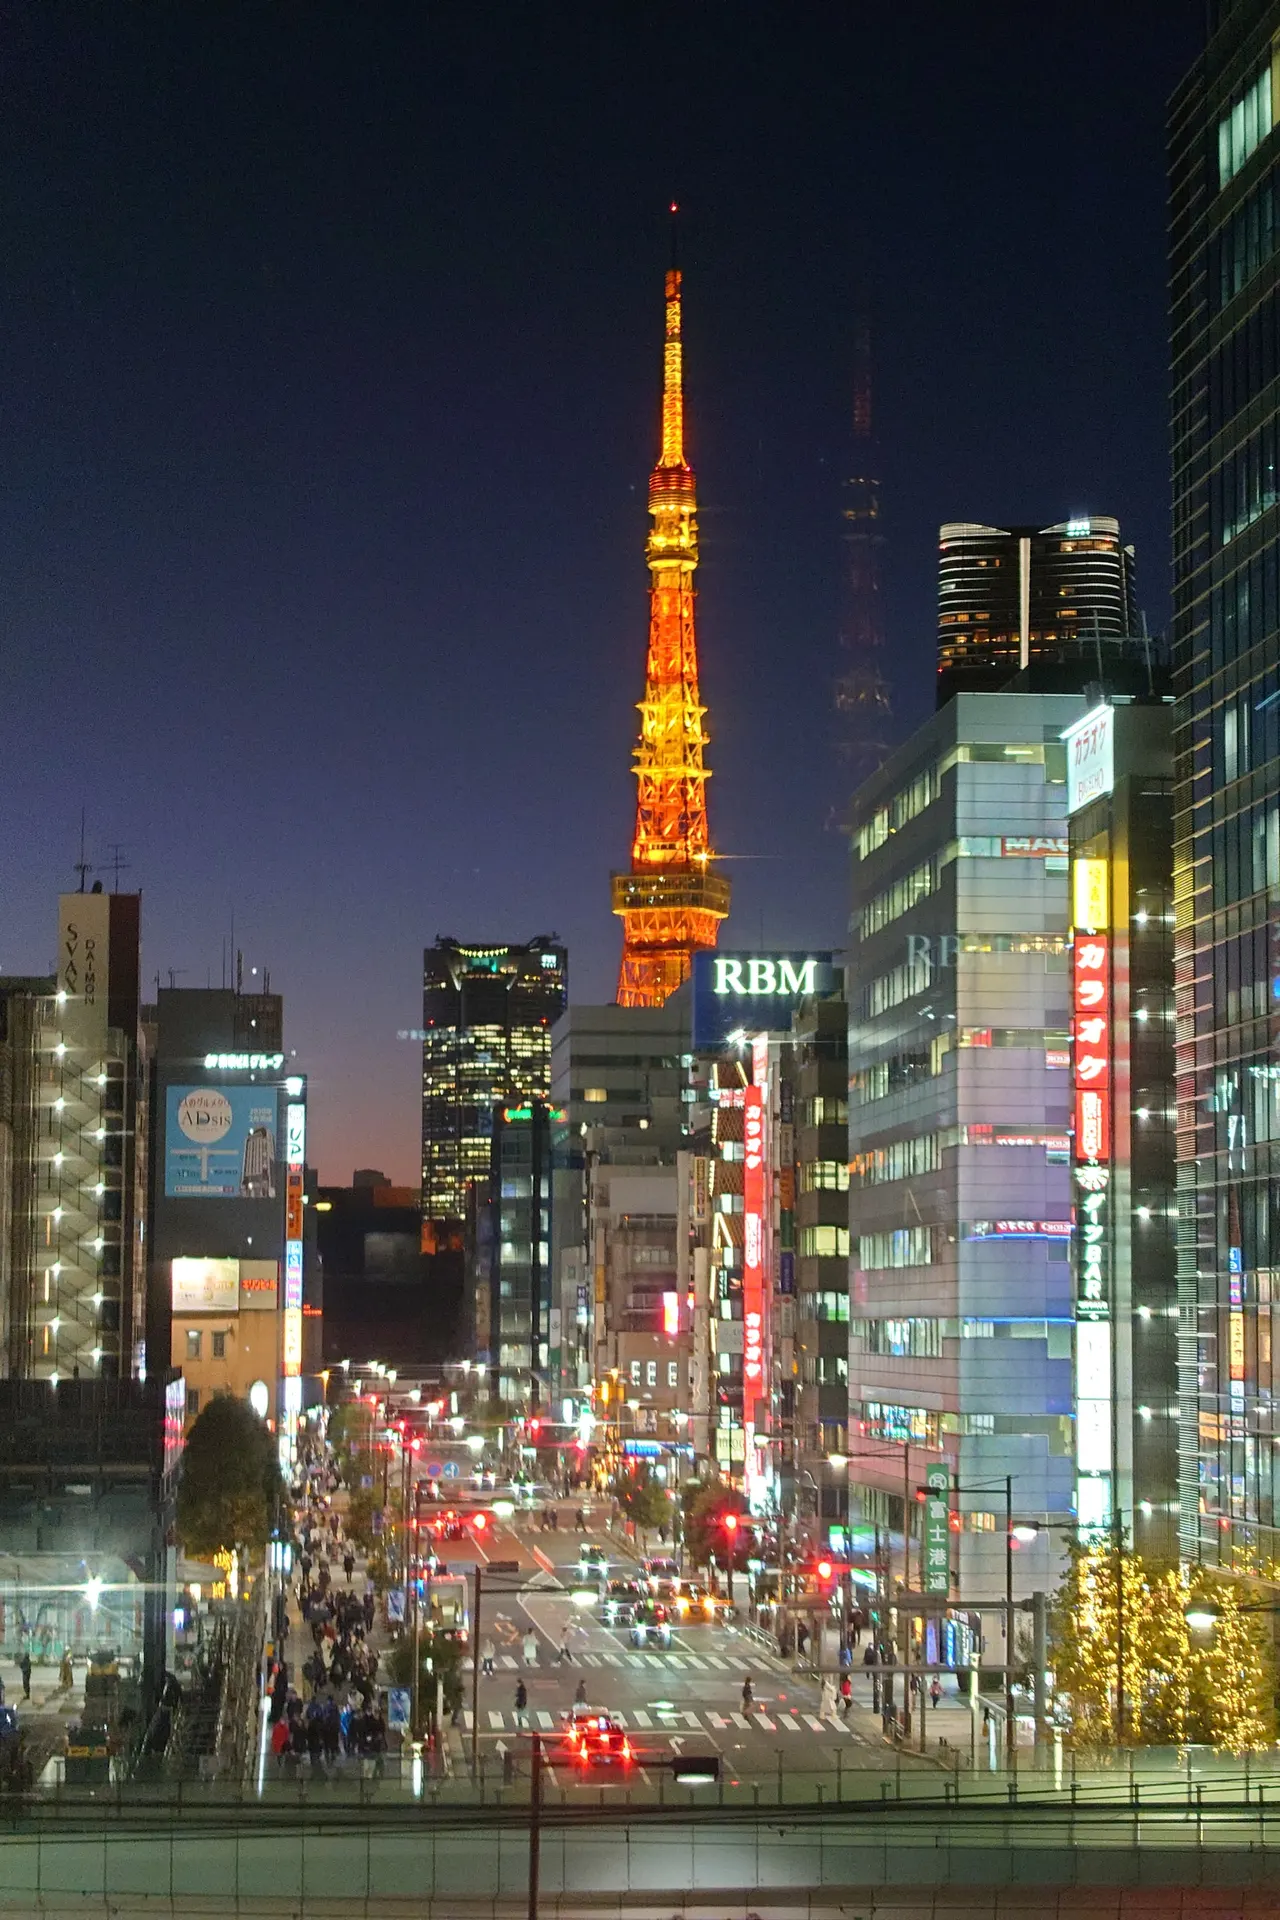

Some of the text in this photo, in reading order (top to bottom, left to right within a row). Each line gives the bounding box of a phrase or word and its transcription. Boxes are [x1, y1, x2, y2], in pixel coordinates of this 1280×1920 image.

[1076, 721, 1106, 766] カラオケ
[85, 939, 96, 1005] DAIMON
[713, 958, 817, 995] RBM
[1077, 943, 1106, 1081] カラオケ
